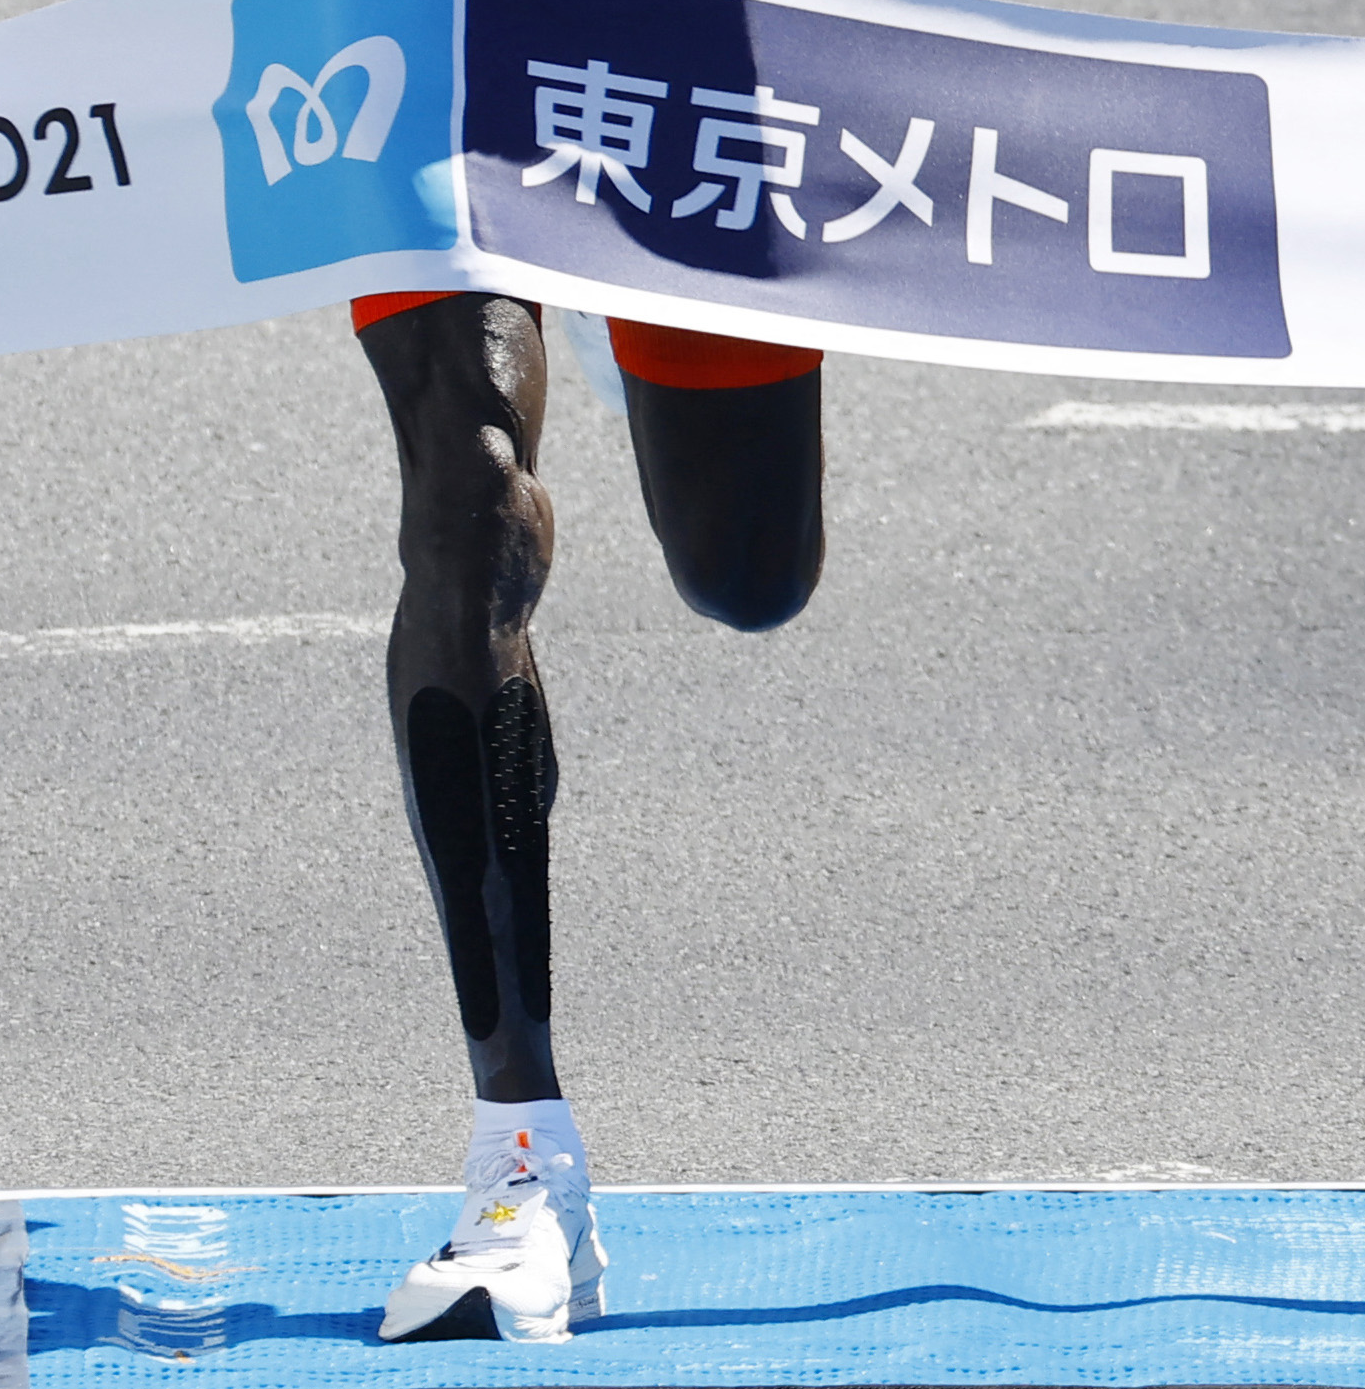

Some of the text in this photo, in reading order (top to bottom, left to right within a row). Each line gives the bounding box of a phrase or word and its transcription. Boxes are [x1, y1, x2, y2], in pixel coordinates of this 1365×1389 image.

[520, 59, 1212, 279] 東京メトロ
